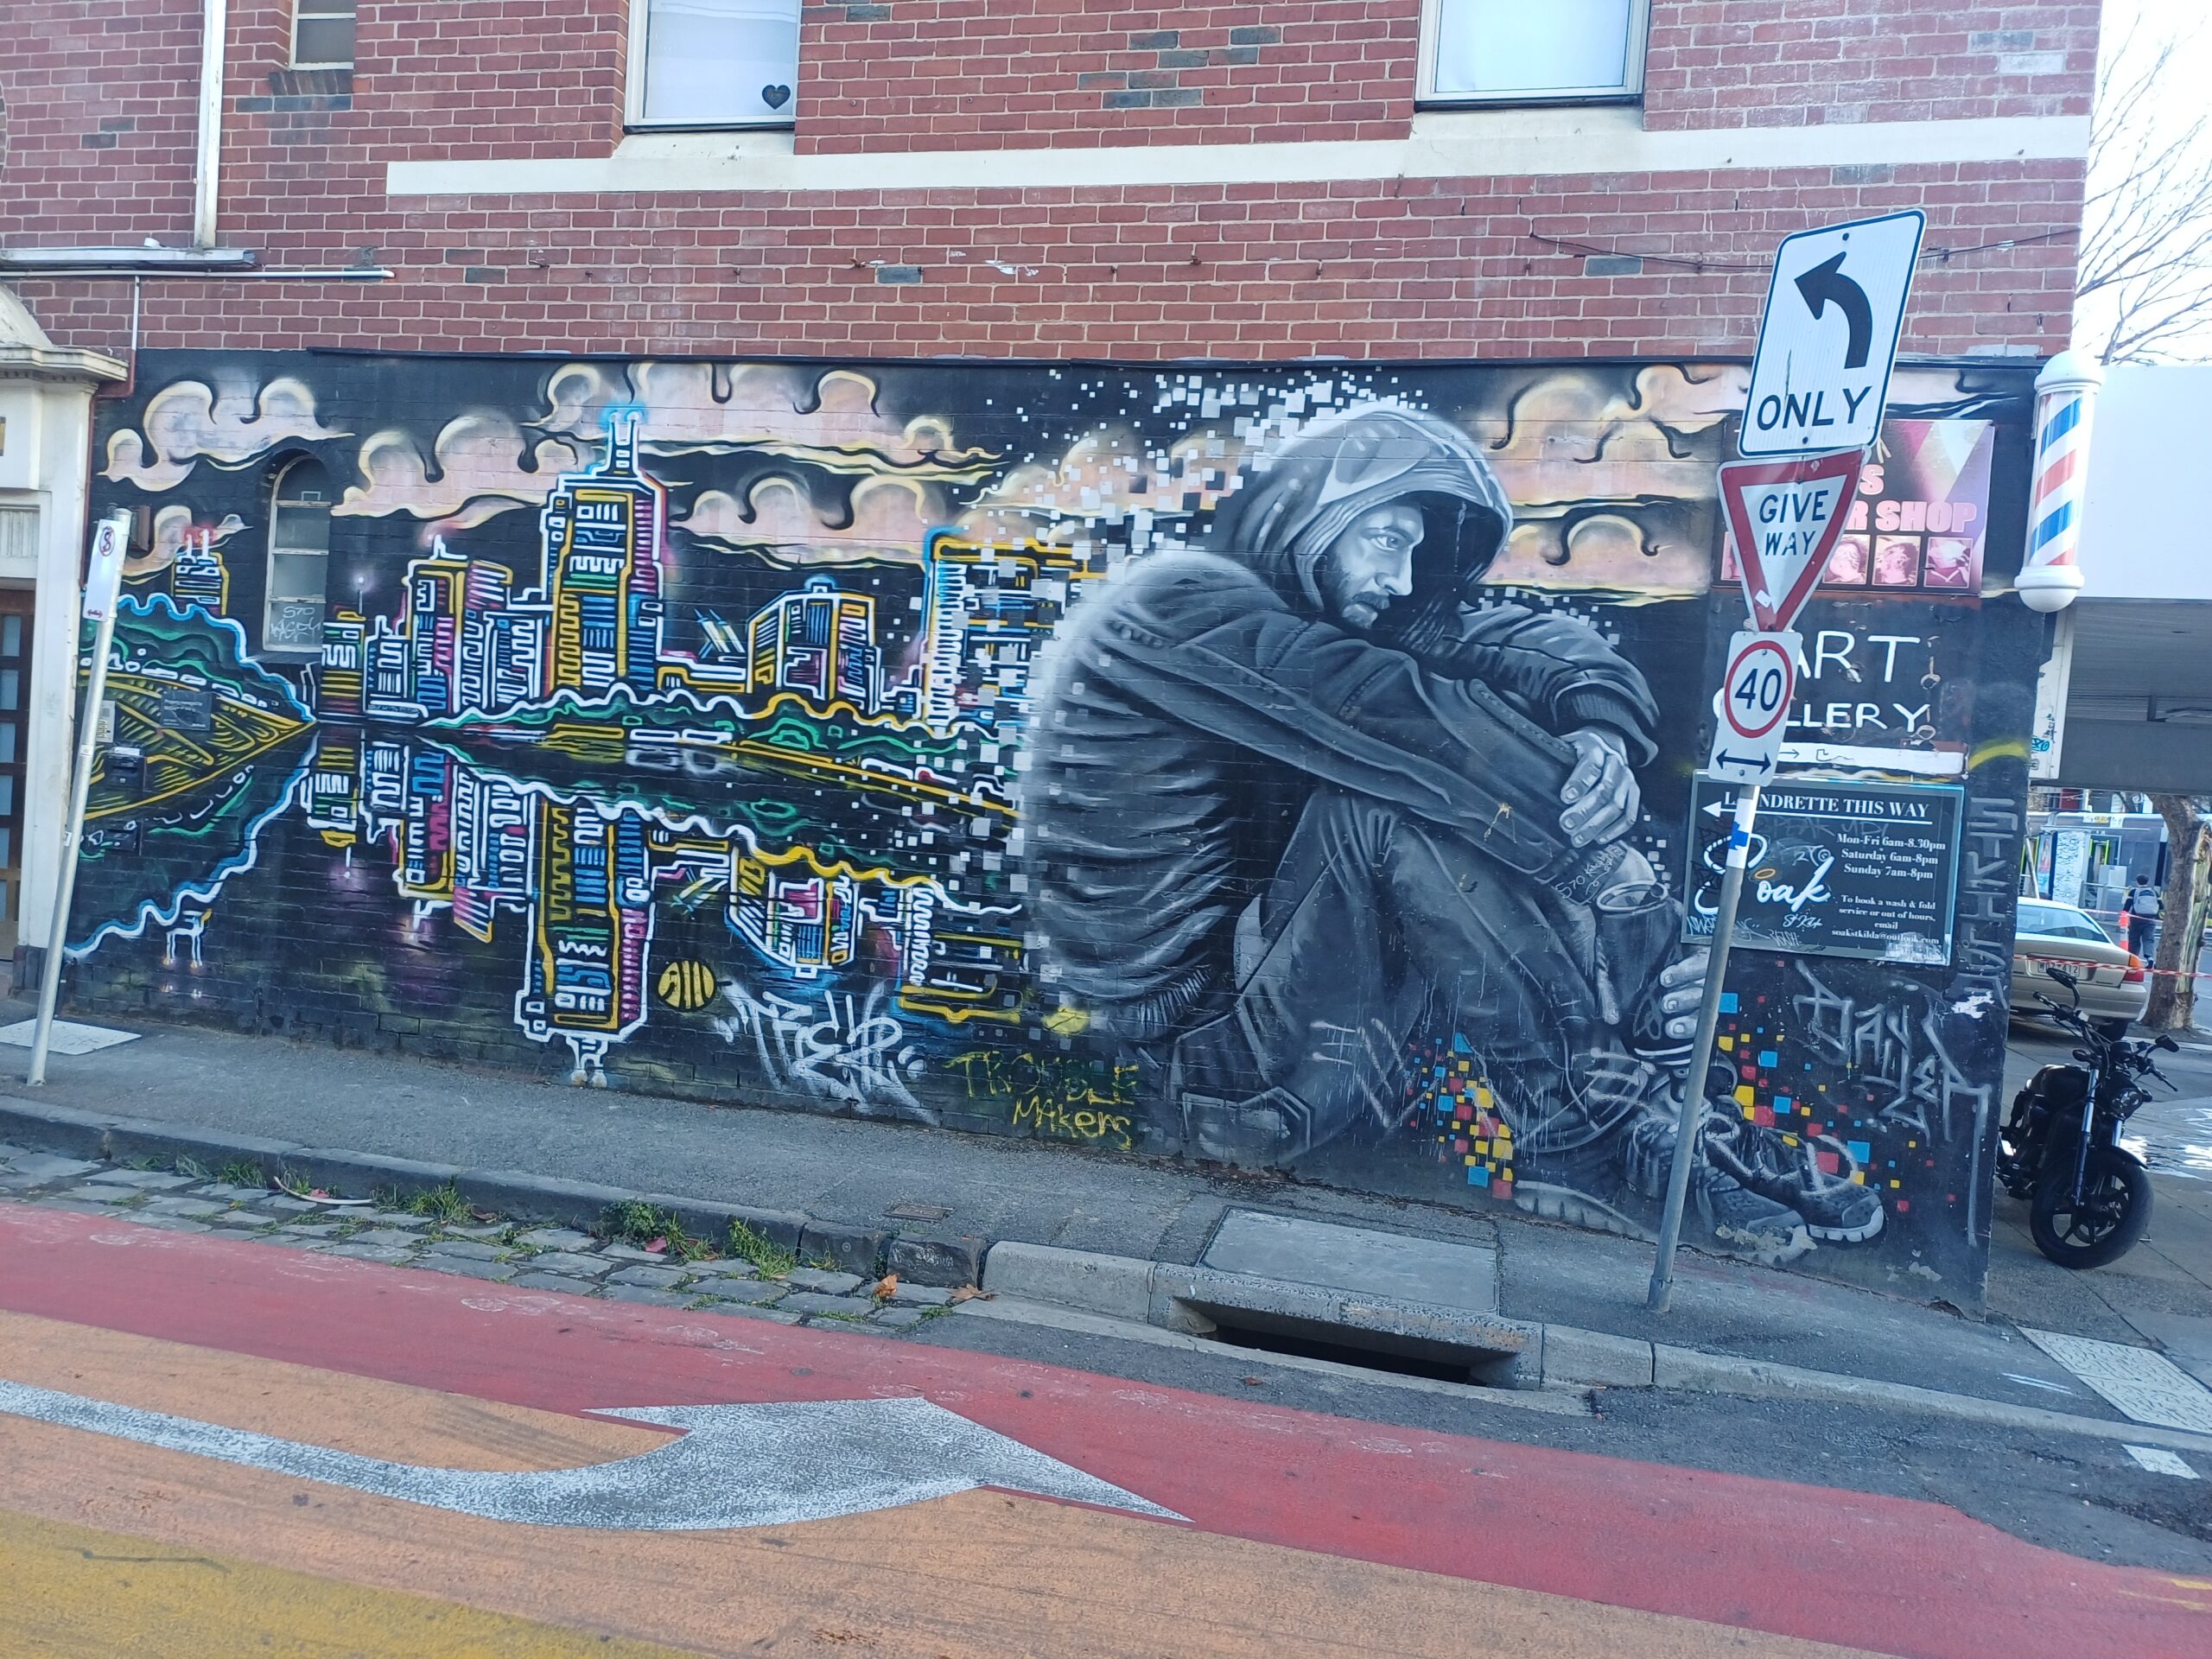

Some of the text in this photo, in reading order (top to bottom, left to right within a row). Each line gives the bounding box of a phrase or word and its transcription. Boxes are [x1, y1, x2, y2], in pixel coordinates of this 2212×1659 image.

[1757, 385, 1872, 431] ONLY
[1759, 489, 1829, 524] GIVE
[1875, 499, 1978, 533] SHOP
[1765, 531, 1816, 556] WAY
[1734, 668, 1782, 712] 40
[1713, 688, 1931, 733] LERY
[1725, 791, 1930, 817] LNDRETTE THIS WAY
[1837, 833, 1947, 852] Mon-Fri 6am-8.30pm
[1841, 849, 1887, 864] Saturday
[1890, 851, 1938, 867] 6am-8pm
[1844, 863, 1934, 880] Sunday 7am-8pm
[1839, 906, 1868, 915] service
[1840, 894, 1853, 903] To
[1855, 895, 1876, 906] book
[1918, 901, 1936, 910] fold
[1874, 921, 1898, 930] email
